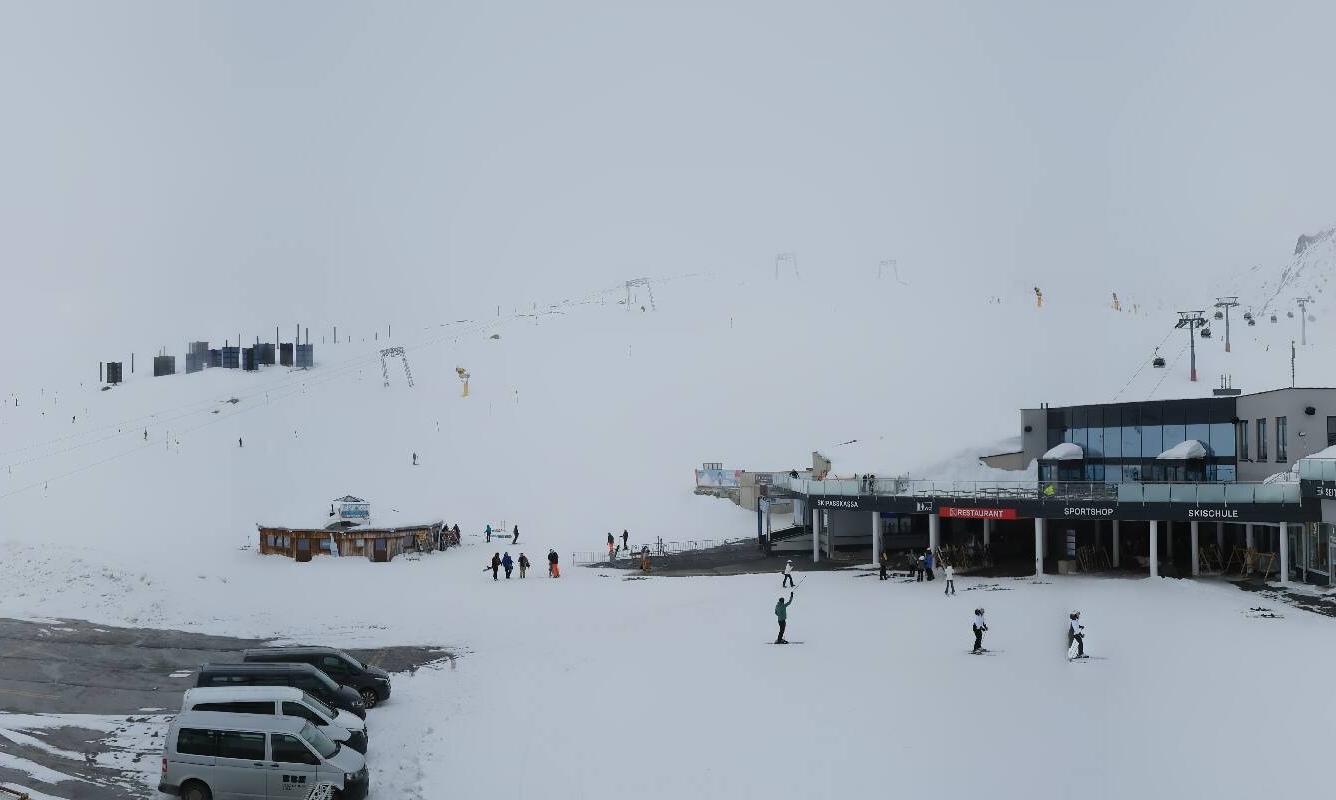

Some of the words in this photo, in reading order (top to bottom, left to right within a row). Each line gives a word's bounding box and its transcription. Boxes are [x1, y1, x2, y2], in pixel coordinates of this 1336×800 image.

[817, 499, 859, 508] SKPASSKASSA
[957, 508, 1004, 518] RESTAURANT
[1063, 507, 1114, 516] SPORTSHOP
[1188, 509, 1239, 518] SKISCHULE
